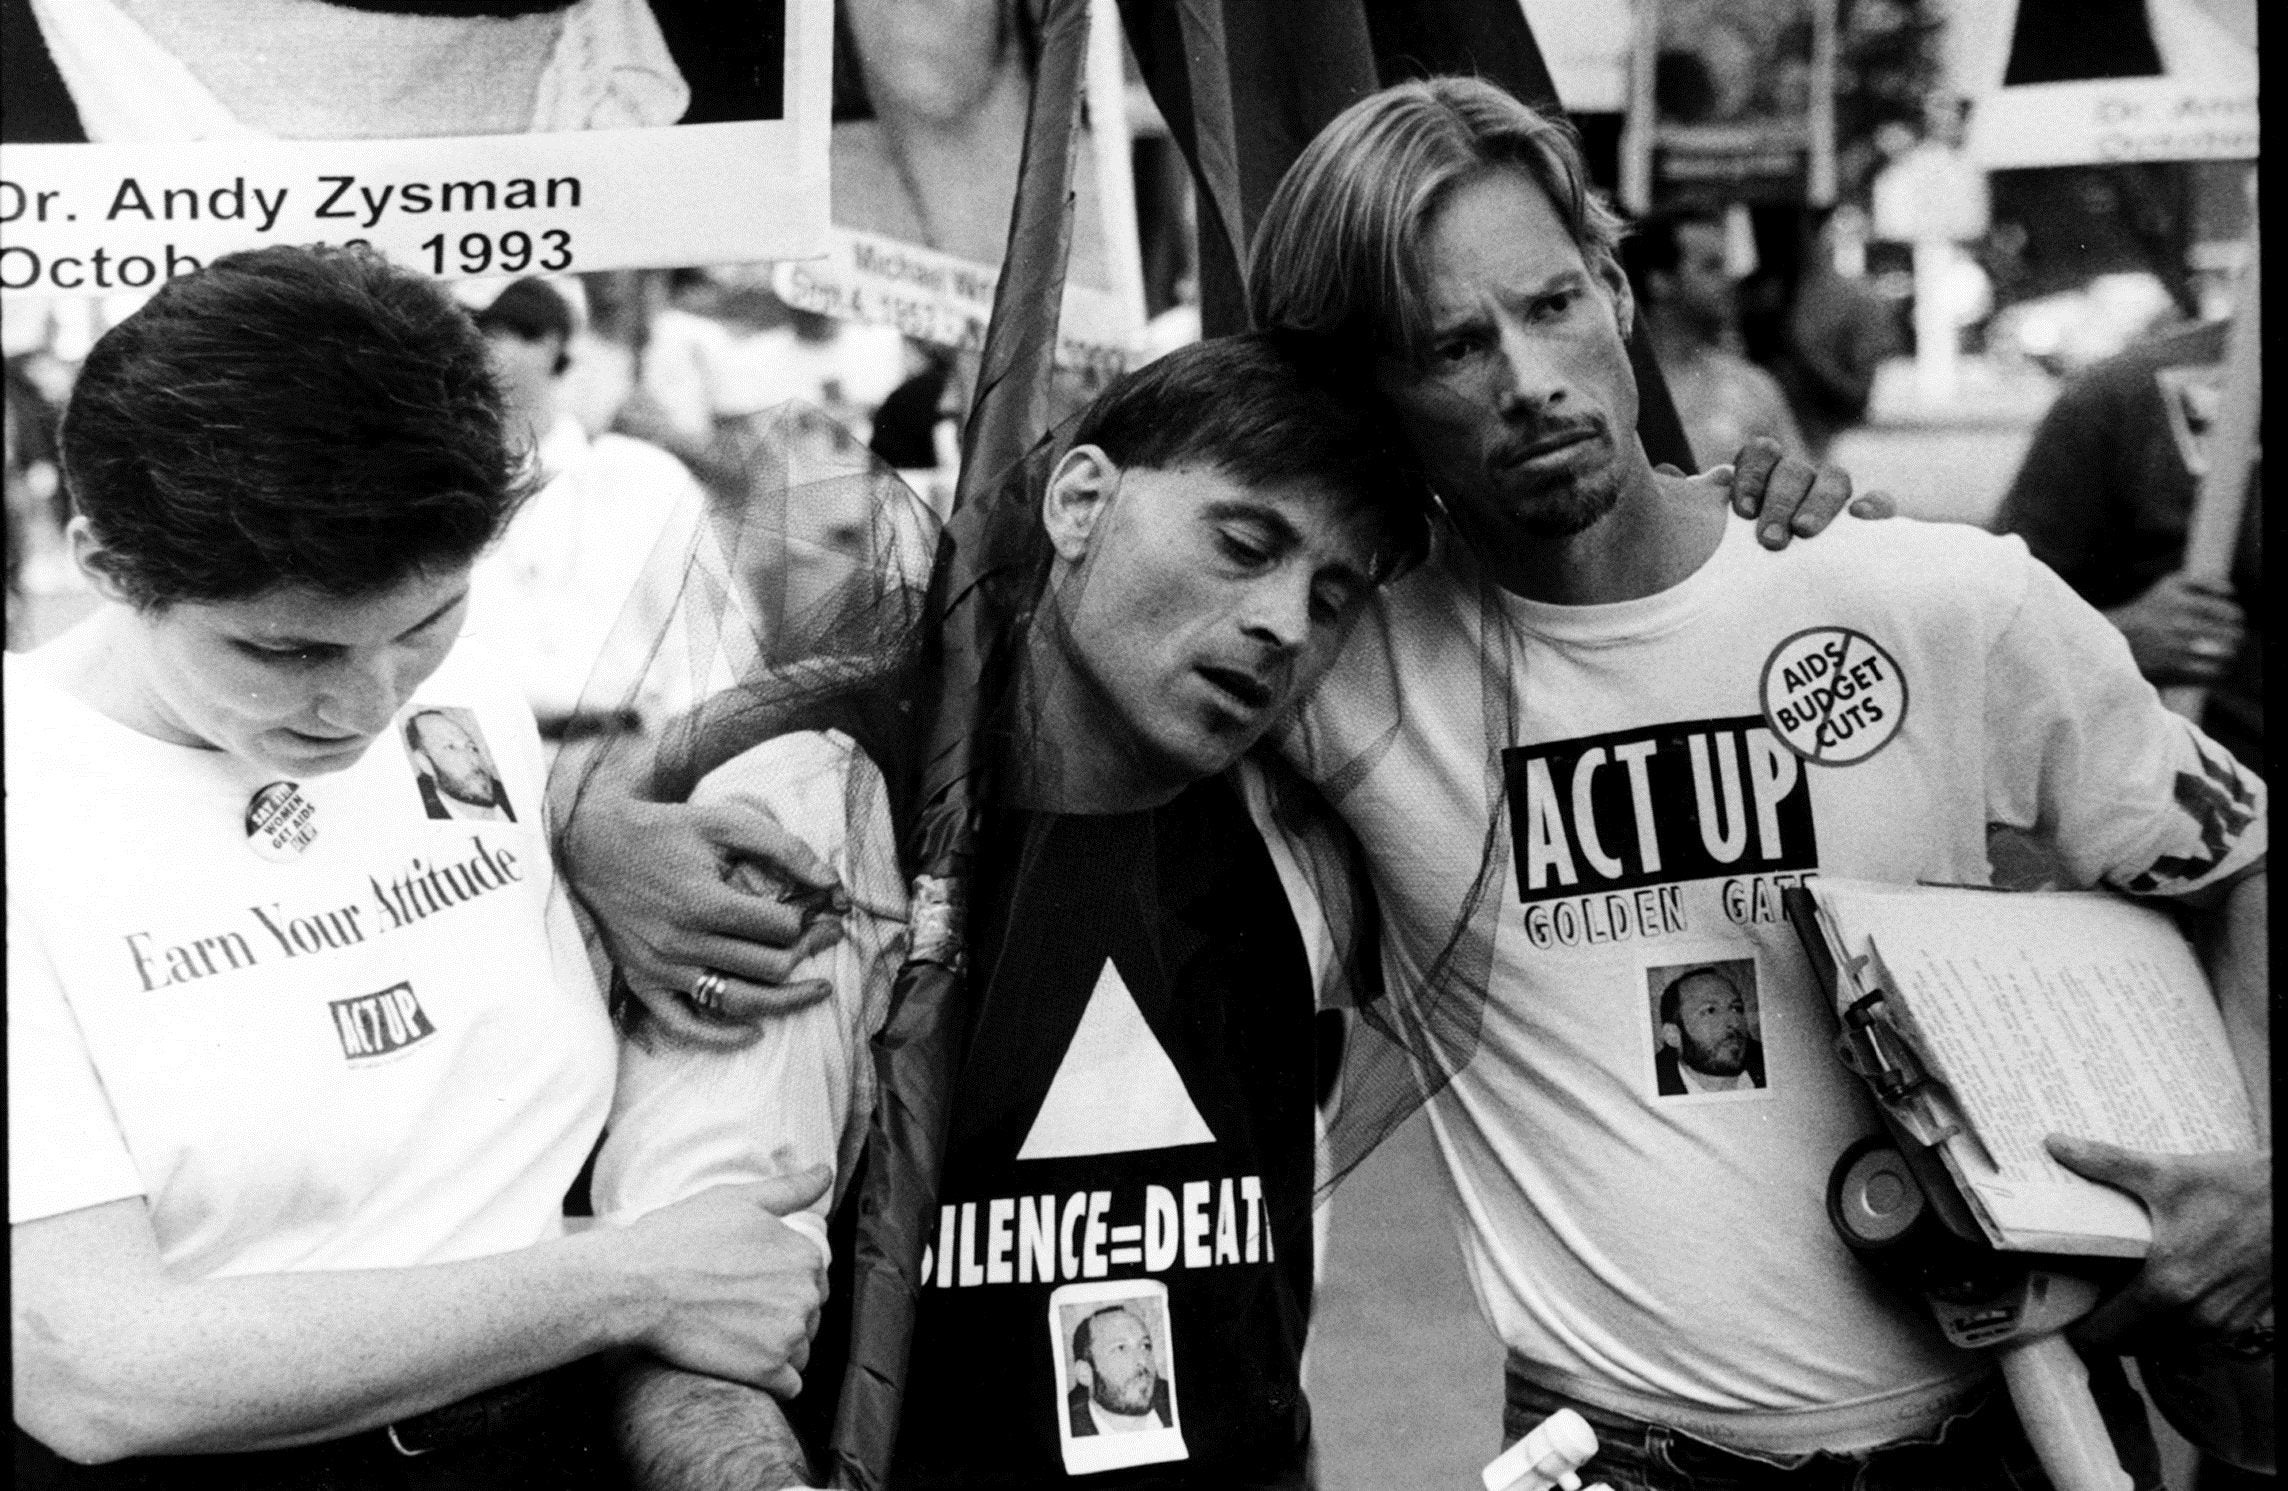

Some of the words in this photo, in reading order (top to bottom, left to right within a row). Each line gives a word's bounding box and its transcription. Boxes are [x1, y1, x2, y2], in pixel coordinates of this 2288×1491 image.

[0, 180, 76, 223] Dr.
[106, 176, 288, 232] Andy
[315, 176, 581, 228] Zysman
[0, 244, 204, 289] Octob
[421, 229, 573, 275] 1993
[1776, 655, 1884, 733] BUDGET
[1783, 642, 1845, 694] AIDS
[1815, 697, 1884, 747] CUTS
[263, 794, 304, 836] WOMEN
[271, 827, 293, 850] GET
[292, 802, 316, 829] AIDS
[1526, 739, 1662, 891] ACT
[1687, 727, 1798, 864] UP
[123, 928, 260, 994] Earn
[248, 902, 367, 960] Your
[368, 835, 525, 934] Attitude
[1523, 885, 1689, 950] GOLDEN
[1722, 872, 1820, 925] GAT
[921, 1175, 1275, 1289] ILENCE=DEAT
